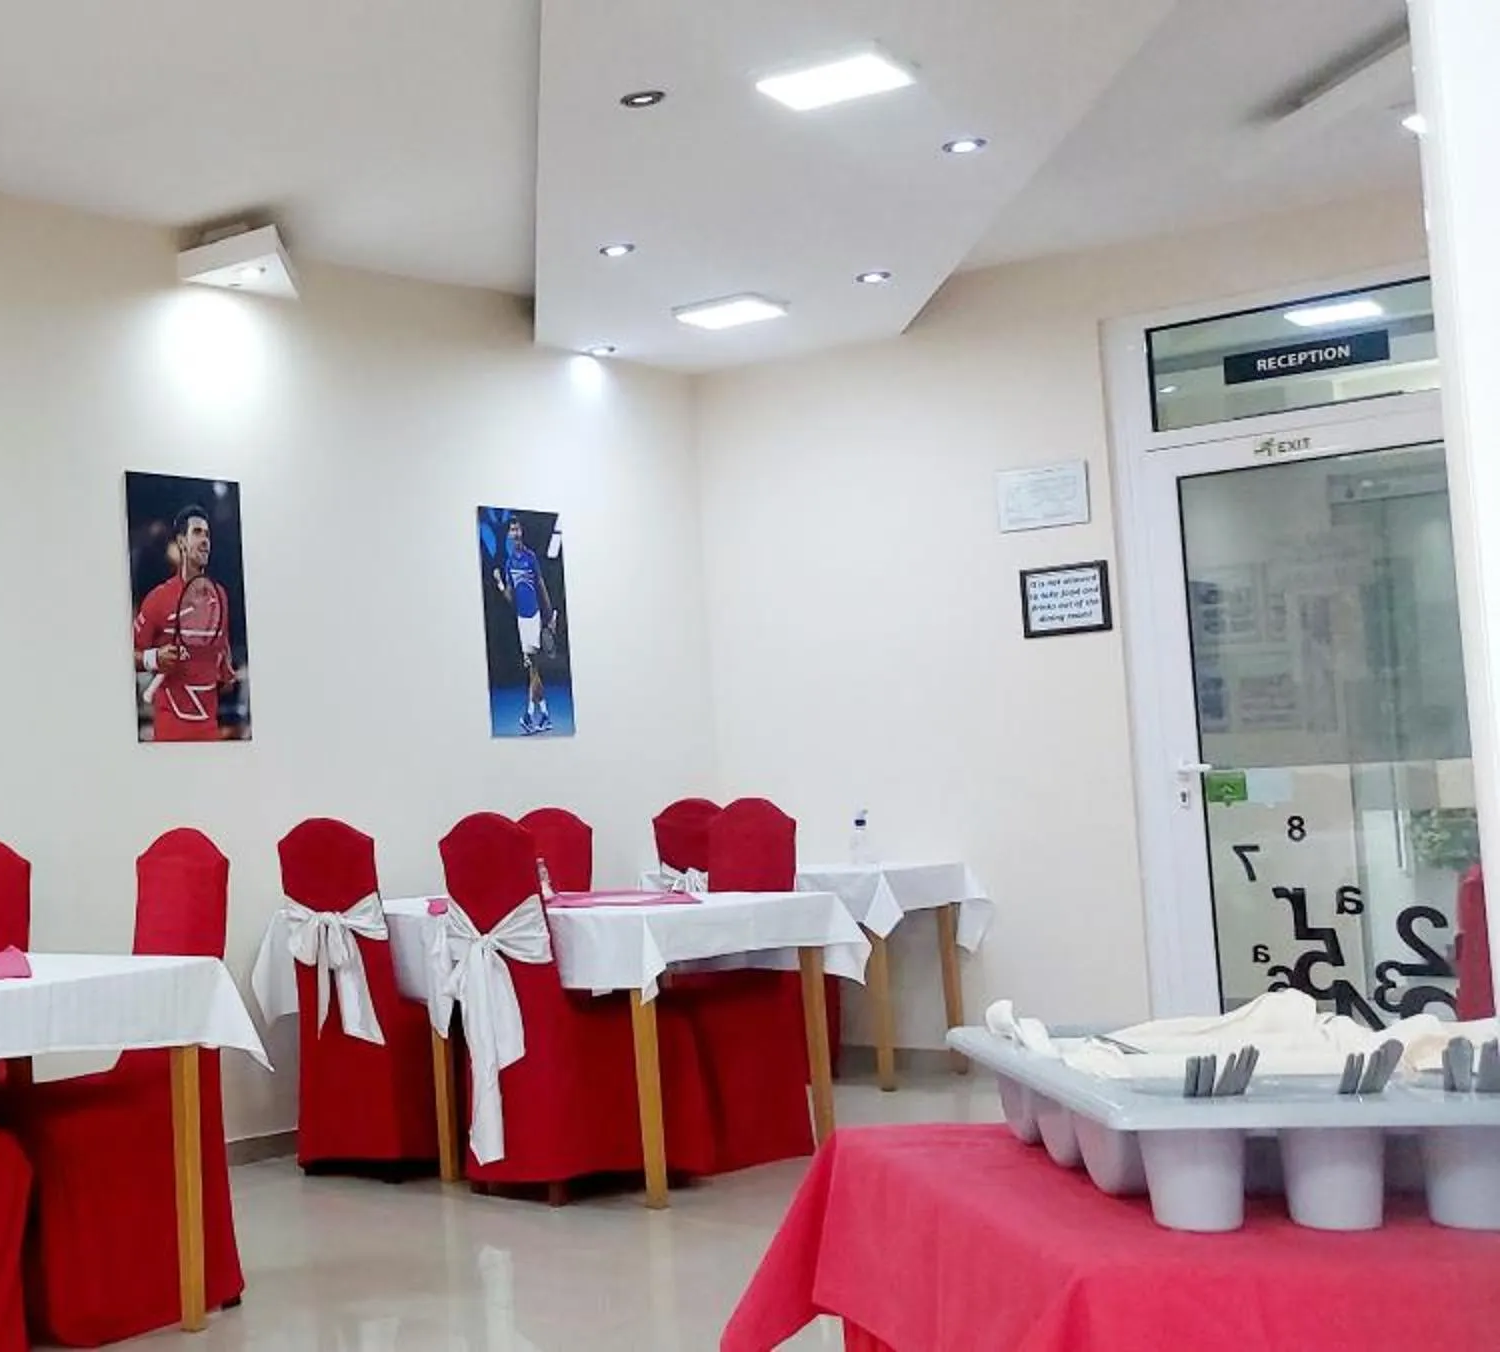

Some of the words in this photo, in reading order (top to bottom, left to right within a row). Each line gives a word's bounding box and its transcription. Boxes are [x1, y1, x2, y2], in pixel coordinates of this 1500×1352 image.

[1257, 345, 1350, 371] RECEPTION
[1278, 437, 1311, 452] EXIT
[1063, 573, 1097, 584] allowed
[1061, 587, 1080, 598] food
[1082, 584, 1098, 594] and
[1074, 600, 1083, 608] of
